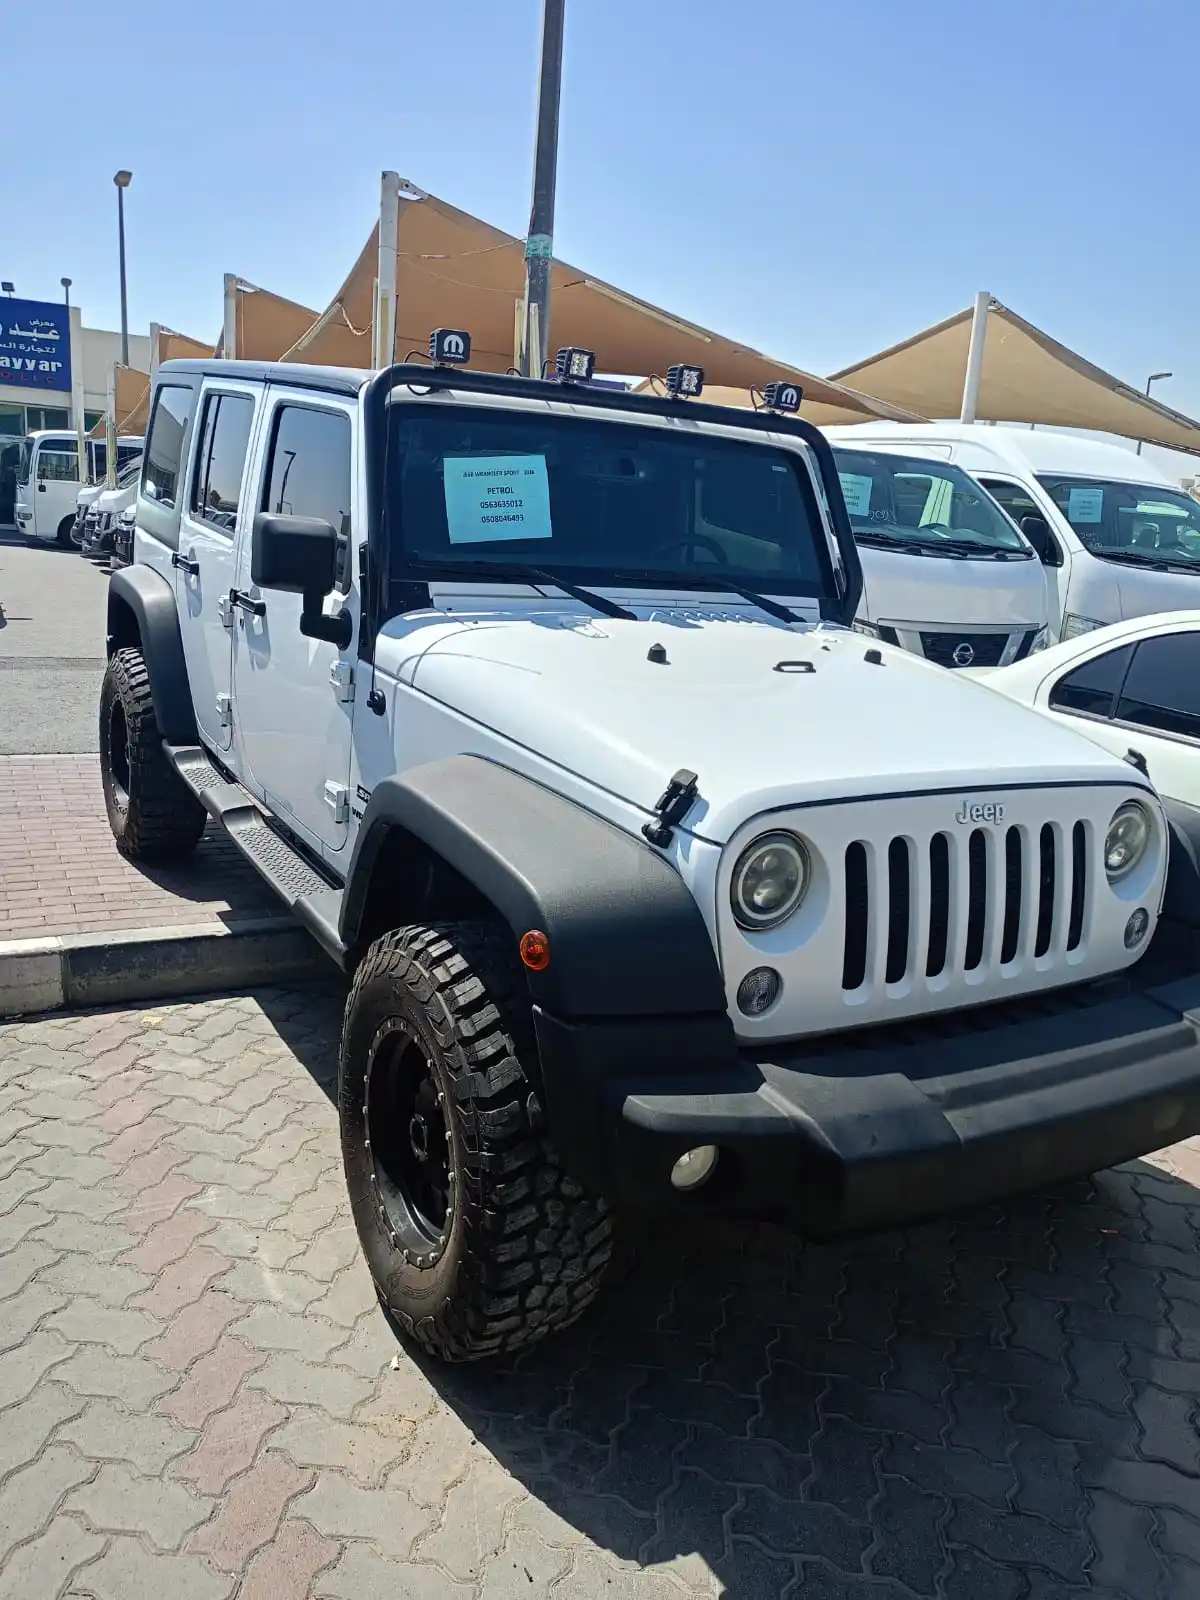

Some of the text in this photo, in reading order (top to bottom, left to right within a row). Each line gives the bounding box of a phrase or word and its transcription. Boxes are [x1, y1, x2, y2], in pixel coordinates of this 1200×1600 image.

[29, 318, 55, 327] معرض
[0, 356, 63, 372] ayyar
[487, 486, 515, 495] PETROL
[480, 500, 523, 509] 0563635012
[955, 800, 1005, 825] Jeep
